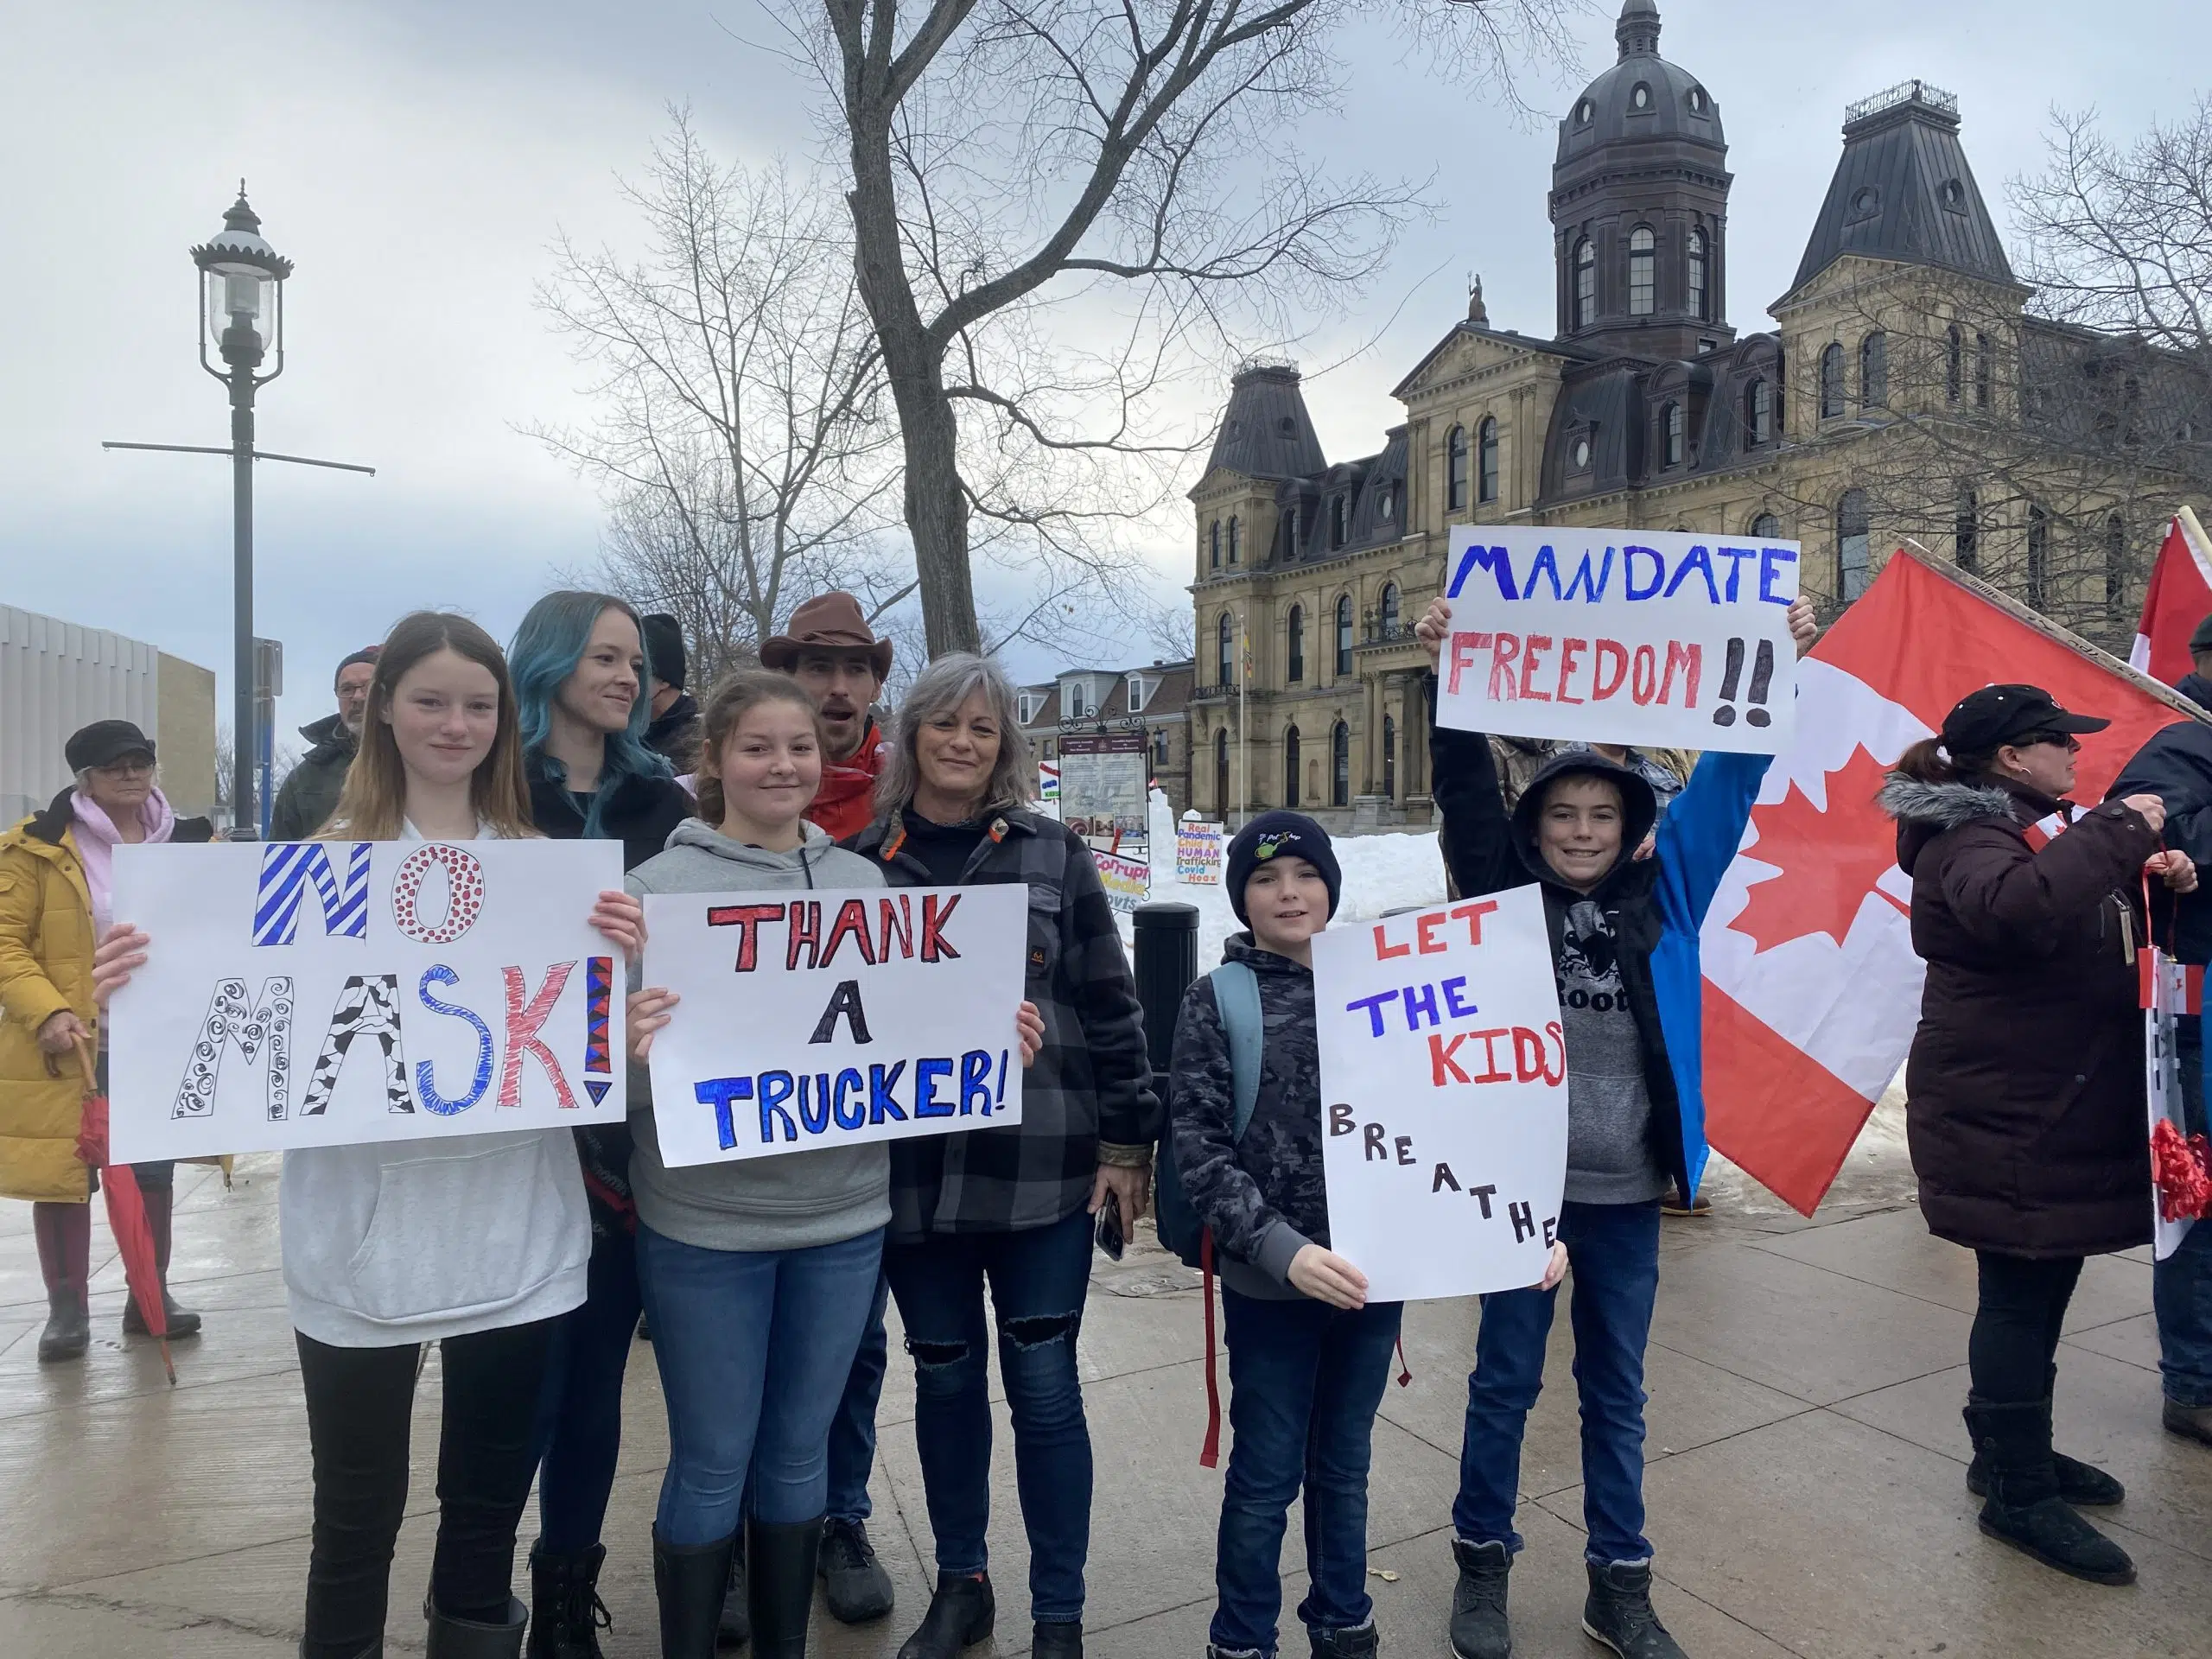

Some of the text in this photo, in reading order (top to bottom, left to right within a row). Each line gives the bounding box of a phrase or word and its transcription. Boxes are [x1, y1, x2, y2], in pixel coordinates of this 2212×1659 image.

[1446, 543, 1798, 607] MANDATE
[1178, 829, 1221, 841] Pandemic
[1178, 848, 1220, 858] HUMAN
[1179, 838, 1216, 849] Child &
[1188, 823, 1210, 833] Real
[251, 842, 486, 948] NO
[1093, 854, 1150, 880] Corrupt
[1178, 865, 1205, 874] Covid
[1189, 874, 1216, 883] Hoax
[707, 893, 962, 973] THANK
[1107, 893, 1137, 911] ovts
[1372, 899, 1500, 961] LET
[807, 979, 874, 1045] A
[1345, 976, 1478, 1038] THE
[171, 956, 613, 1122] MASK!
[1427, 1020, 1566, 1088] KIDS
[693, 1048, 1009, 1151] TRUCKER!
[1328, 1103, 1558, 1249] BREATHE
